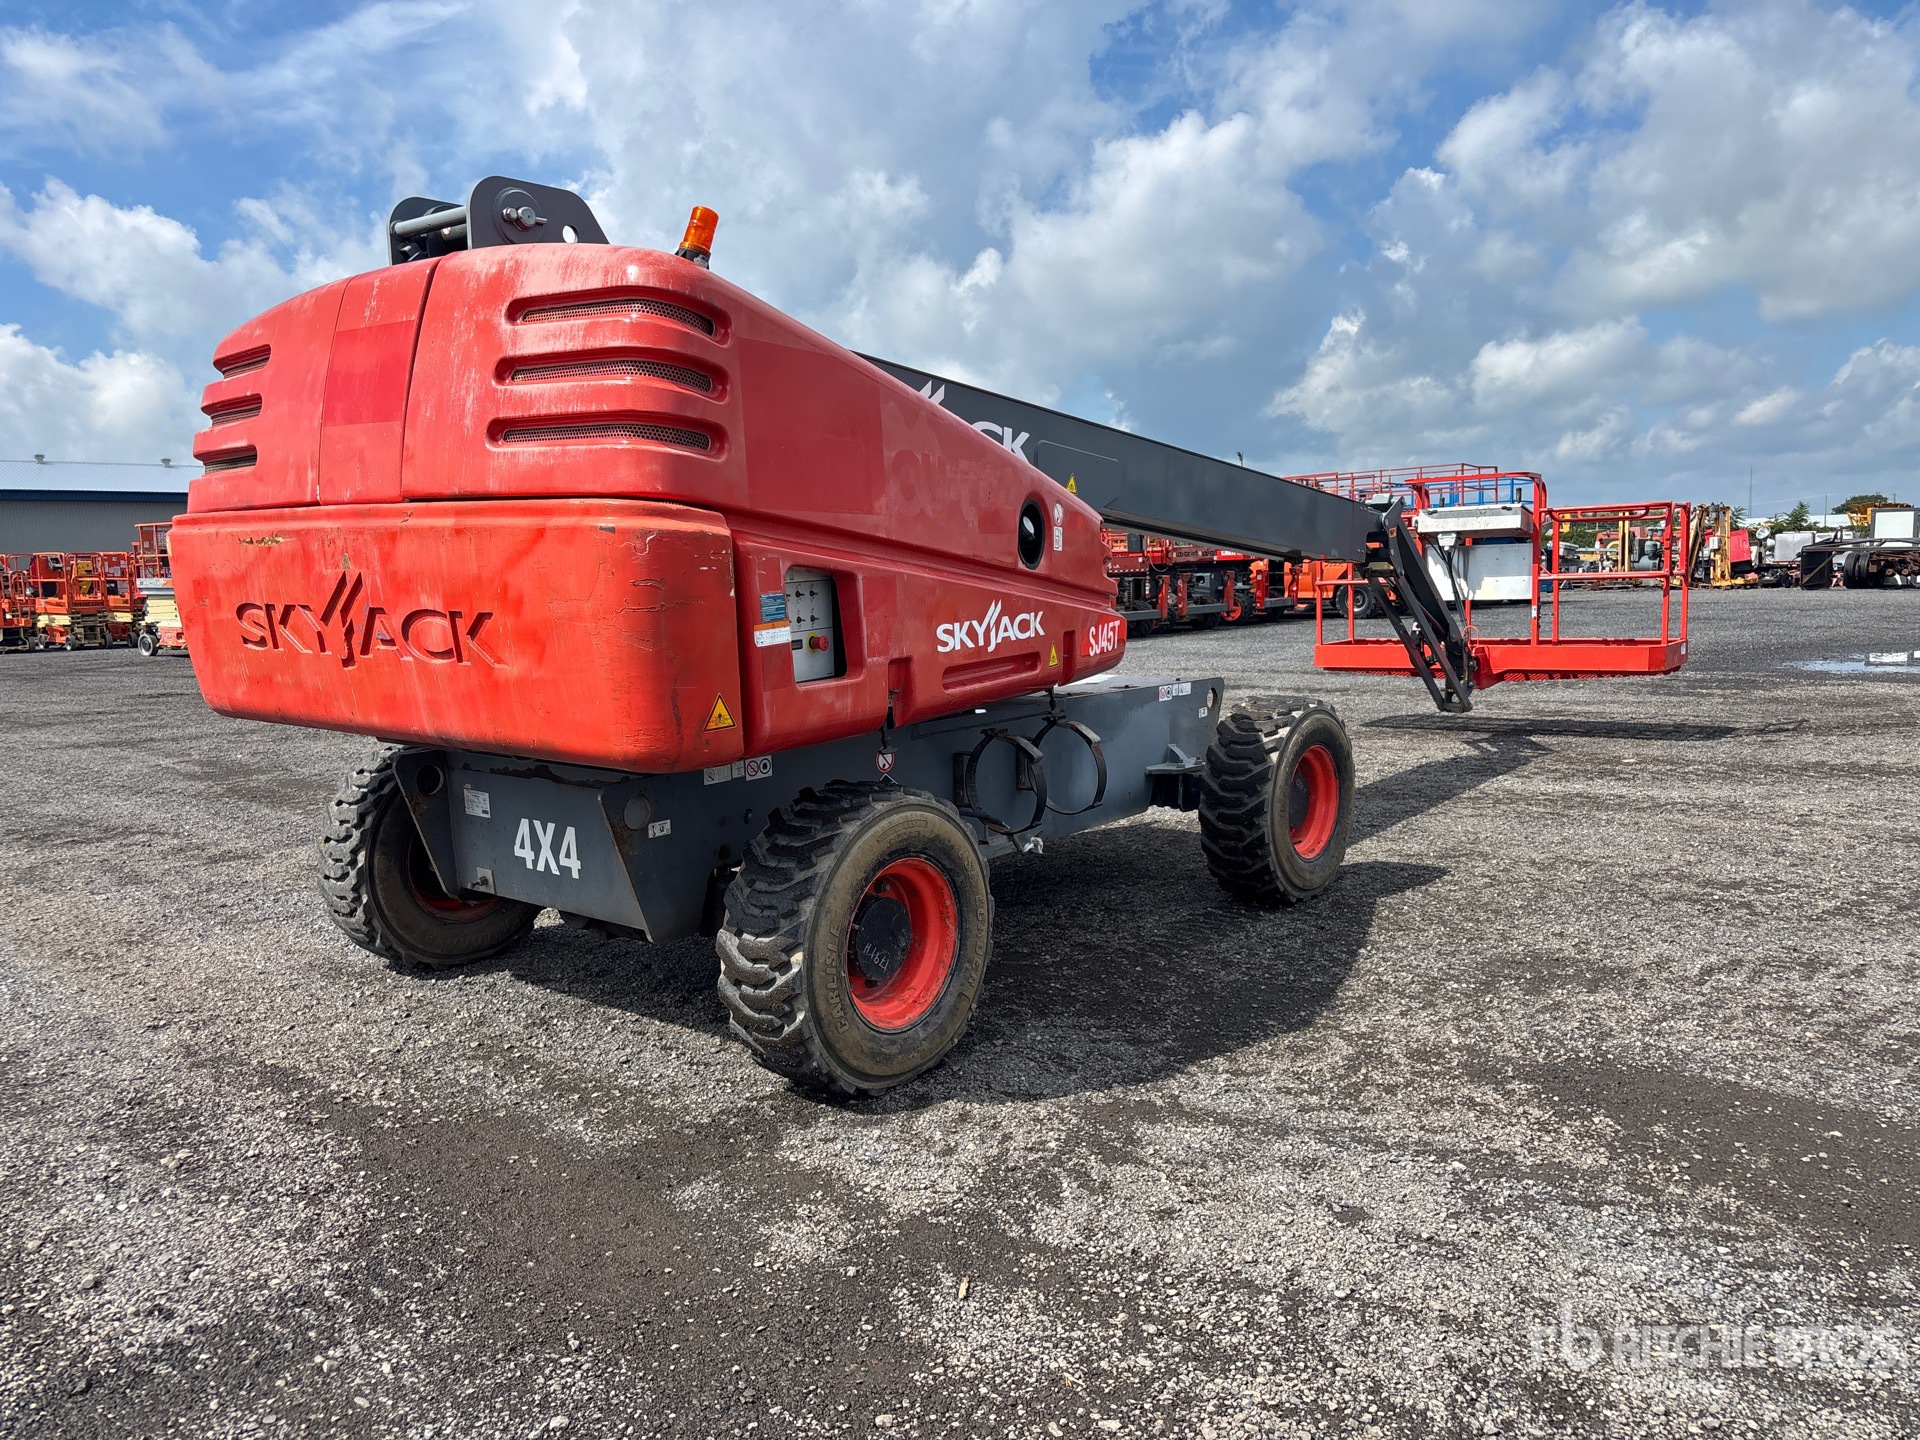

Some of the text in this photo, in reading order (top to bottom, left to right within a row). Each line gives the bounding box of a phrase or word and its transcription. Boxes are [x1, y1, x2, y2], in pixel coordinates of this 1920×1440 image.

[235, 570, 509, 670] SKYJACK
[936, 599, 1045, 652] SKYJACK
[1089, 620, 1121, 657] SJ45T
[514, 818, 581, 879] 4X4
[824, 922, 850, 1034] CARLISLE
